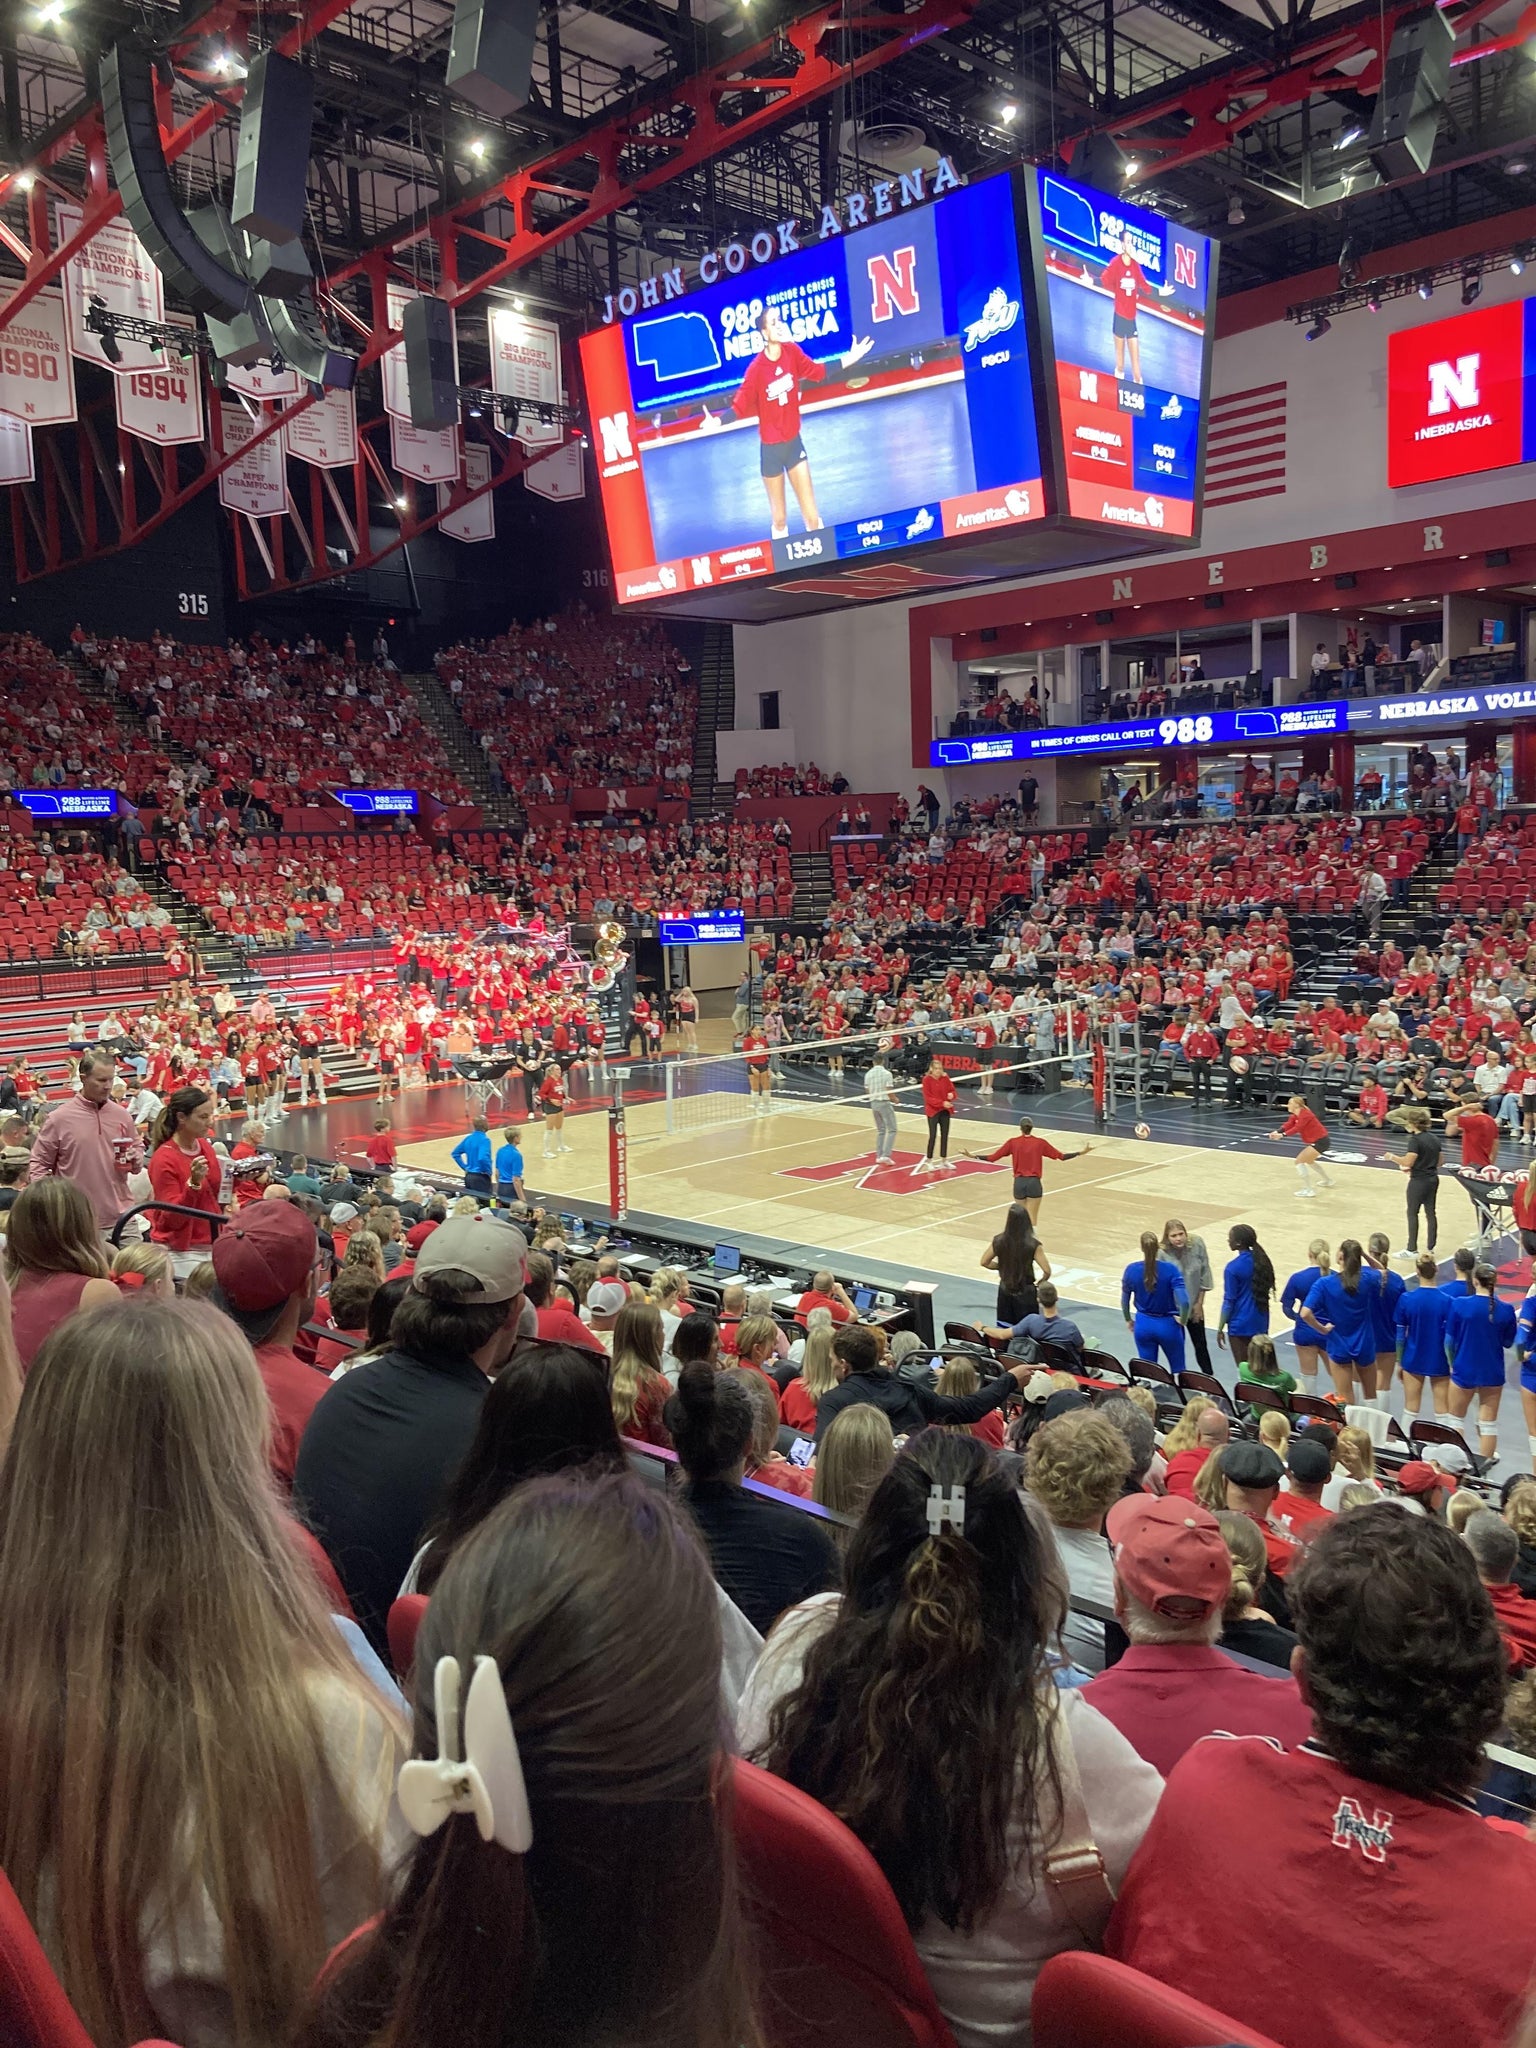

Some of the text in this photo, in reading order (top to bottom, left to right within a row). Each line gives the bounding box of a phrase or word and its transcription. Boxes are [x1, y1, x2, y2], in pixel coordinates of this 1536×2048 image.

[602, 156, 961, 323] JOHN COOK ARENA
[73, 258, 150, 283] CHAMPIONS
[81, 247, 142, 270] NATIONAL
[1174, 243, 1197, 289] N
[765, 276, 835, 306] SUICIDE & CRISIS
[867, 245, 920, 323] N
[781, 290, 838, 321] FELINE
[3, 324, 53, 342] ATIONAL
[130, 372, 188, 404] 1994
[1428, 353, 1480, 417] N
[25, 402, 36, 414] N
[157, 423, 167, 434] N
[599, 411, 634, 464] N
[1420, 414, 1492, 440] NEBRASKA
[227, 478, 279, 492] CHAMPIONS
[785, 537, 823, 561] 13:58
[582, 569, 608, 588] 316
[691, 556, 713, 586] N
[179, 592, 208, 615] 315
[1280, 711, 1302, 724] 988
[1303, 713, 1336, 721] LIFELINE
[1379, 691, 1536, 720] NEBRASKA VOLL
[1159, 716, 1214, 745] 988
[1280, 719, 1336, 732] NEBRASKA
[1031, 728, 1155, 748] IN TIMES OF CRISIS CALL OR TEXT
[62, 797, 81, 805] 988
[607, 790, 627, 808] N
[617, 1137, 627, 1221] NEBRASK
